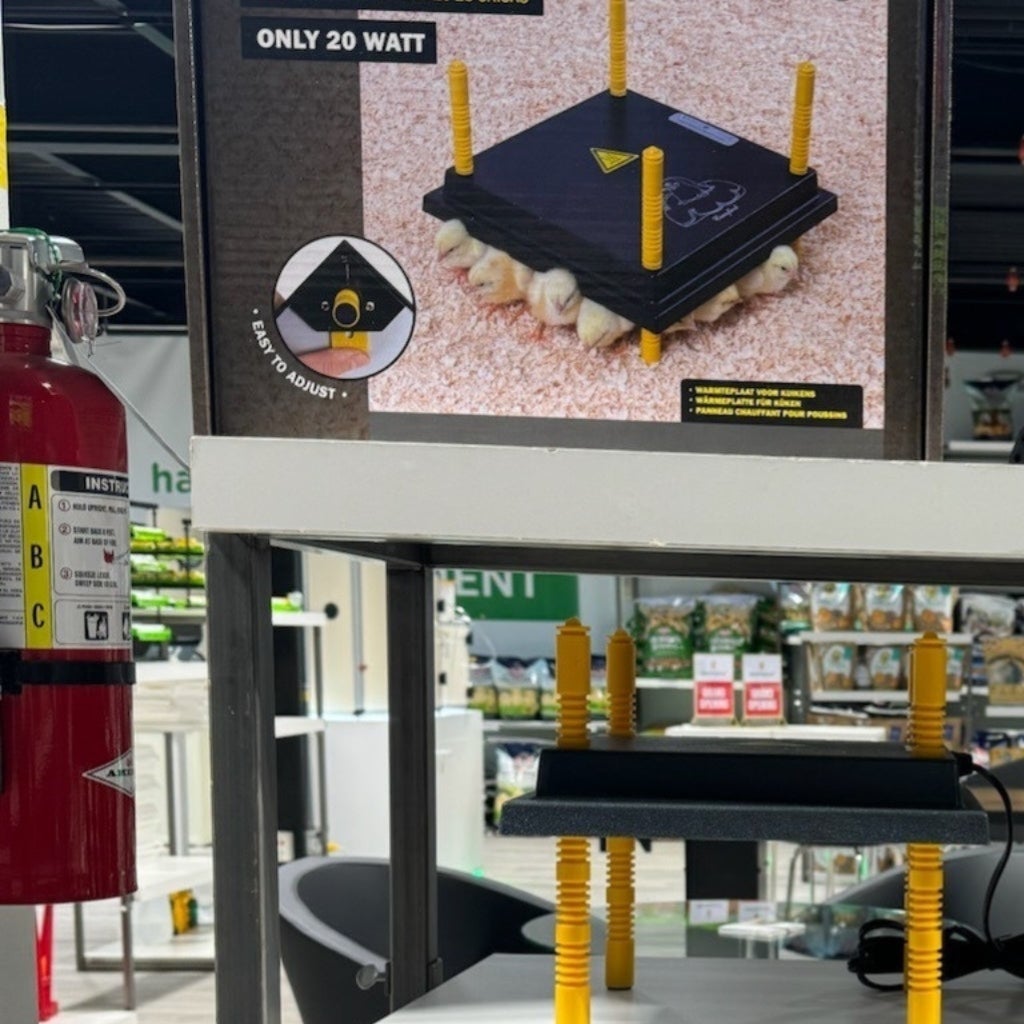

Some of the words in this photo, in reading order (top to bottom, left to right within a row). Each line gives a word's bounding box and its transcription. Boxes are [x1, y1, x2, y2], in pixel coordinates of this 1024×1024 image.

[256, 28, 320, 50] ONLY
[326, 31, 357, 51] 20
[363, 32, 426, 53] WATT
[252, 320, 276, 354] EASY
[271, 354, 287, 373] TO
[285, 371, 336, 400] ADJUST
[28, 484, 42, 510] A
[31, 544, 43, 569] B
[446, 568, 535, 598] ENT
[32, 603, 45, 628] C
